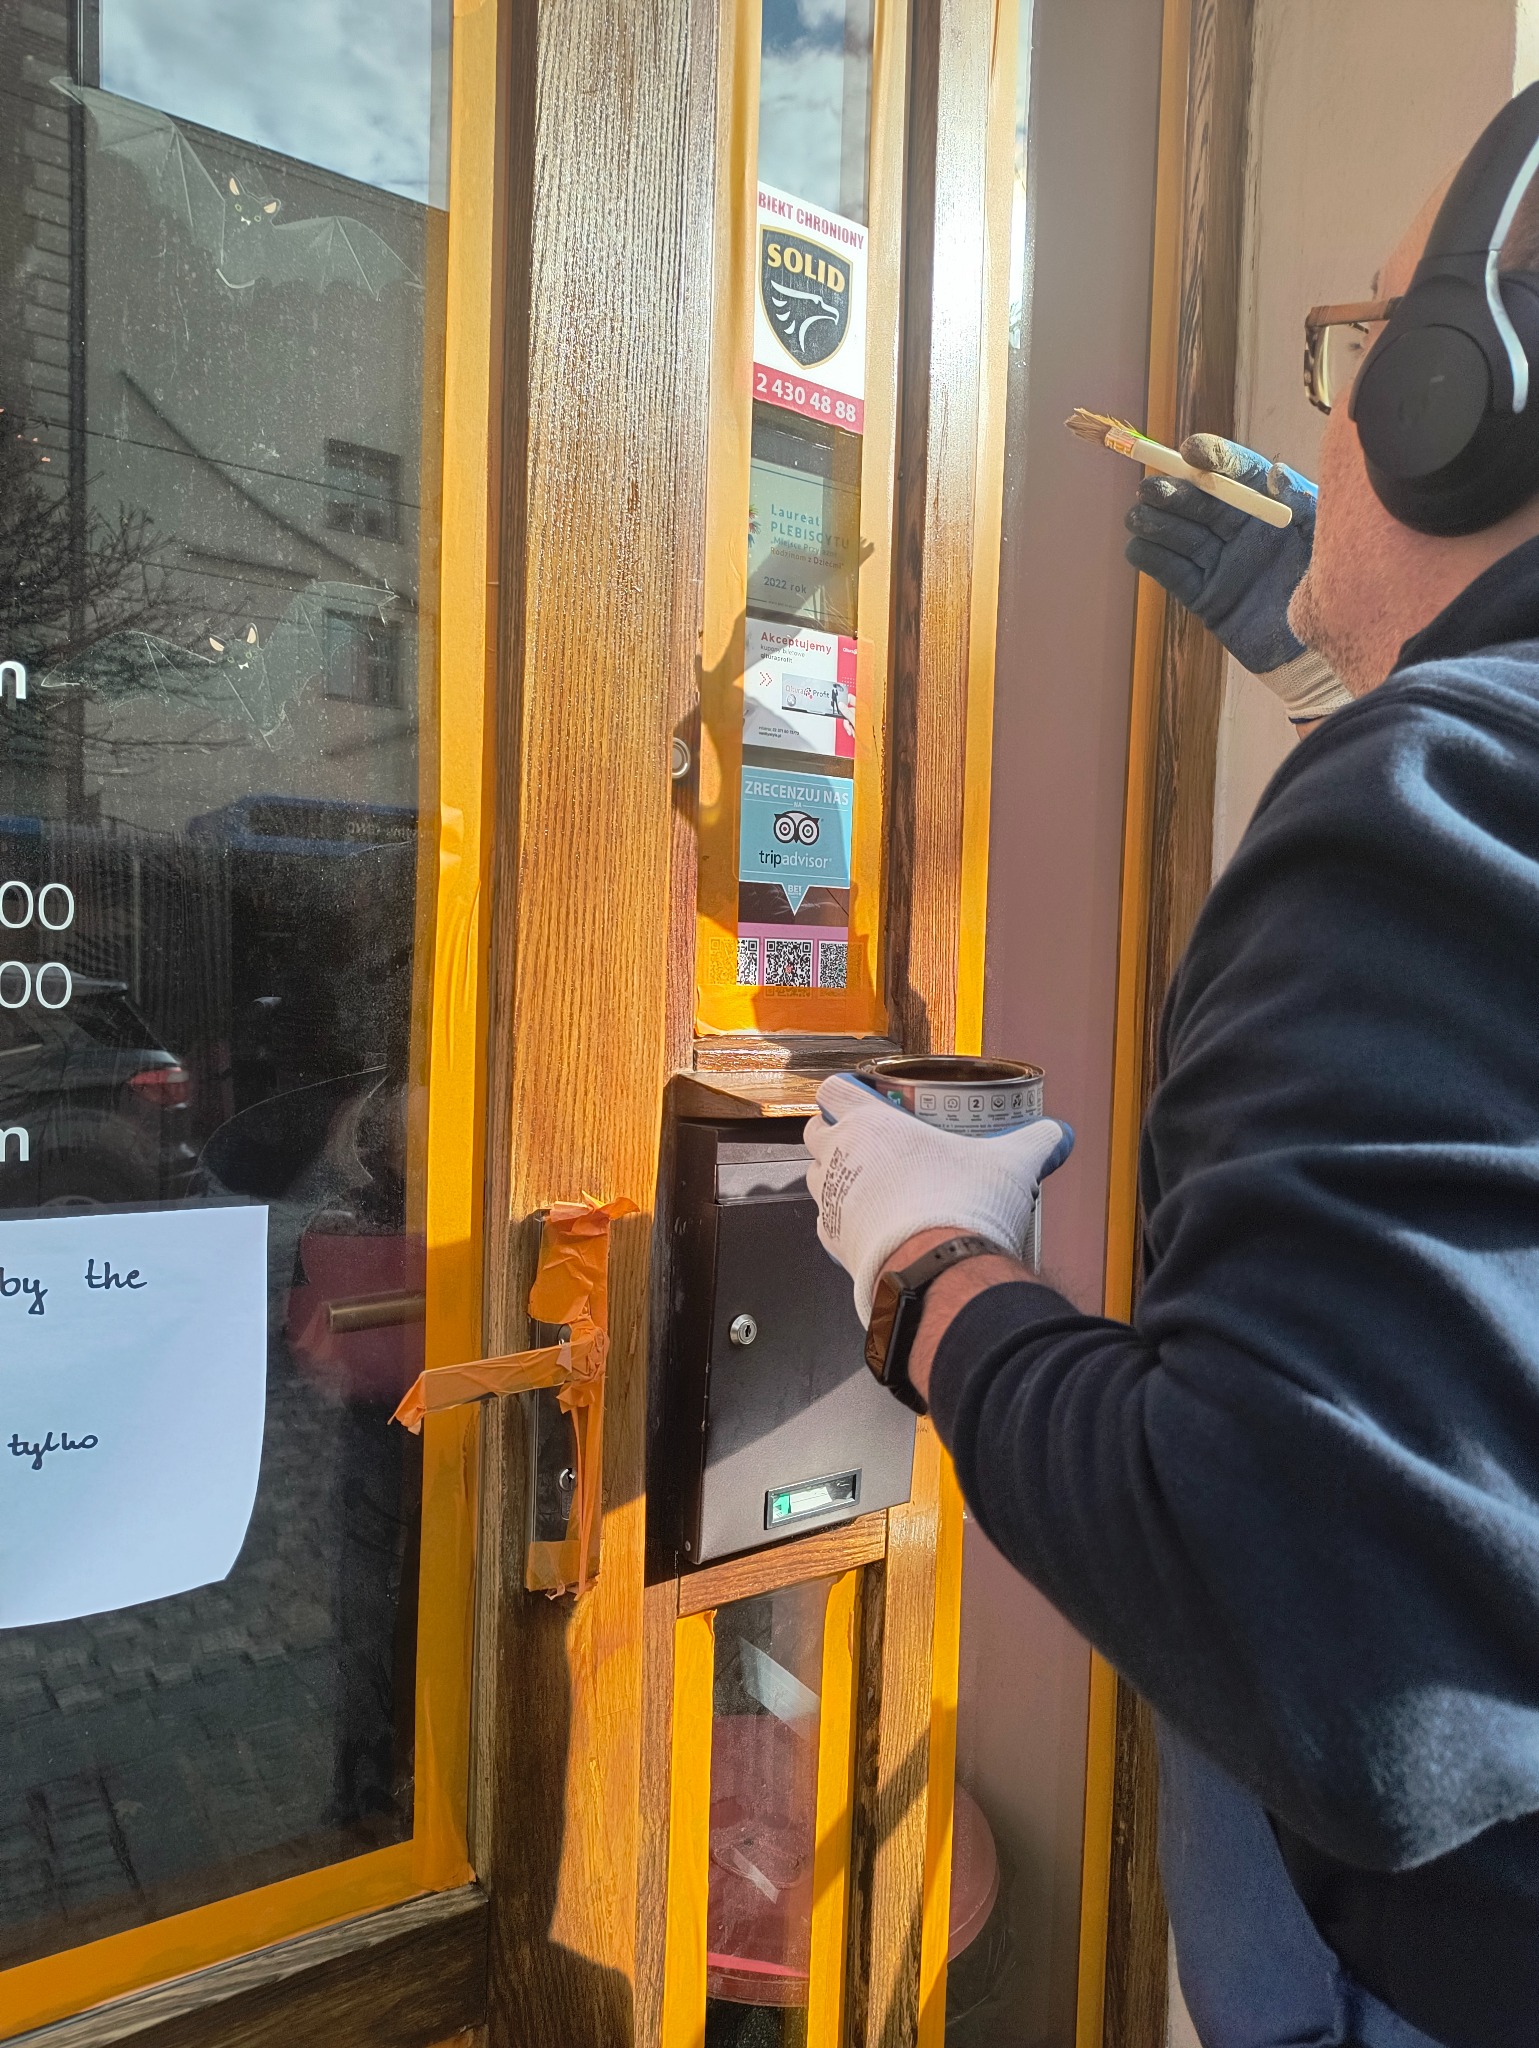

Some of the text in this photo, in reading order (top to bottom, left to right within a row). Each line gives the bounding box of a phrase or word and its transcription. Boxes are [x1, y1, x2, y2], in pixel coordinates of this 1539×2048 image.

[796, 208, 864, 250] CHRONIONY
[767, 243, 845, 293] SOLID
[756, 373, 856, 423] 2 430 48 88
[771, 504, 820, 527] Laureat
[770, 521, 850, 550] PLEBISCYTU
[763, 576, 807, 594] 2022 rok
[761, 631, 832, 655] Akceptujemy
[744, 780, 849, 806] ZRECENZUJ NAS
[84, 1258, 148, 1290] the
[7, 1431, 99, 1471] tylko
